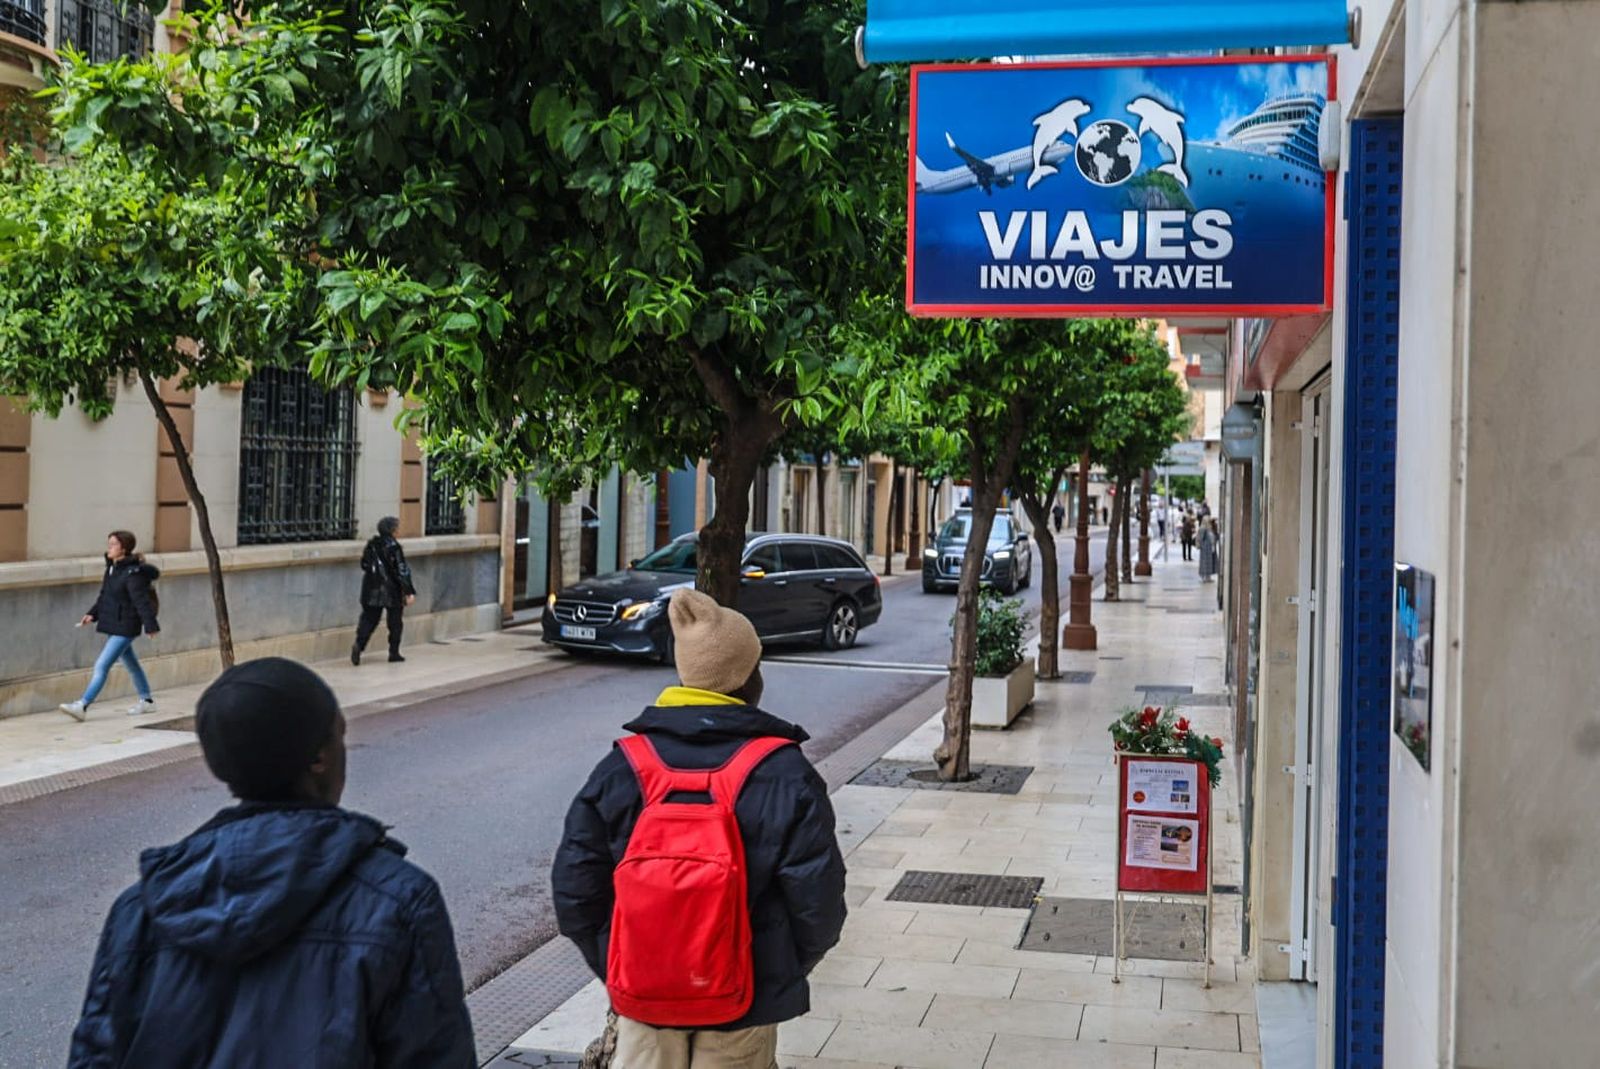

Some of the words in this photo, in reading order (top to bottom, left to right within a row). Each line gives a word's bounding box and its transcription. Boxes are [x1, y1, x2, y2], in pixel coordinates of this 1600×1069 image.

[979, 209, 1234, 260] VIAJES
[980, 265, 1096, 292] INNOV@
[1113, 265, 1233, 289] TRAVEL
